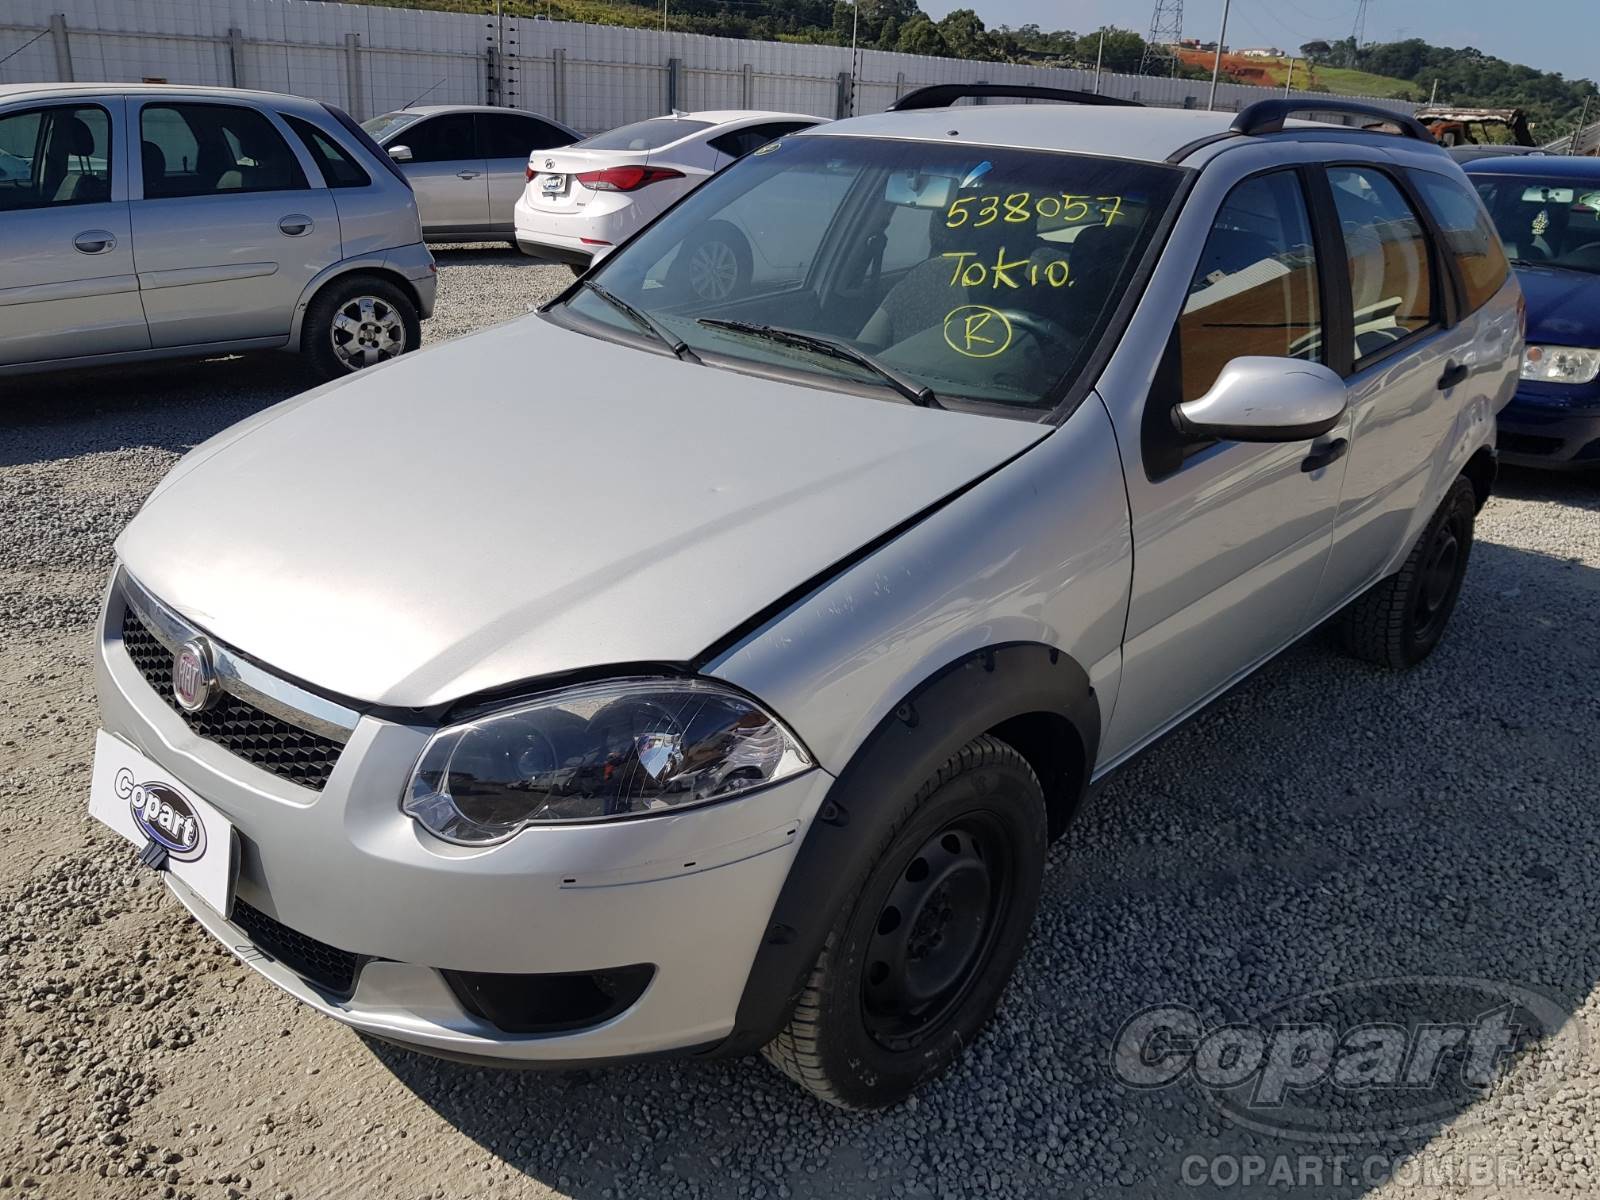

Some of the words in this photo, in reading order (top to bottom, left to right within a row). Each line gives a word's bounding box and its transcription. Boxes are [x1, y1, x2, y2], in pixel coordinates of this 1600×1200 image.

[946, 192, 1125, 227] 538057
[177, 660, 199, 695] FIAT
[115, 767, 197, 846] Copart
